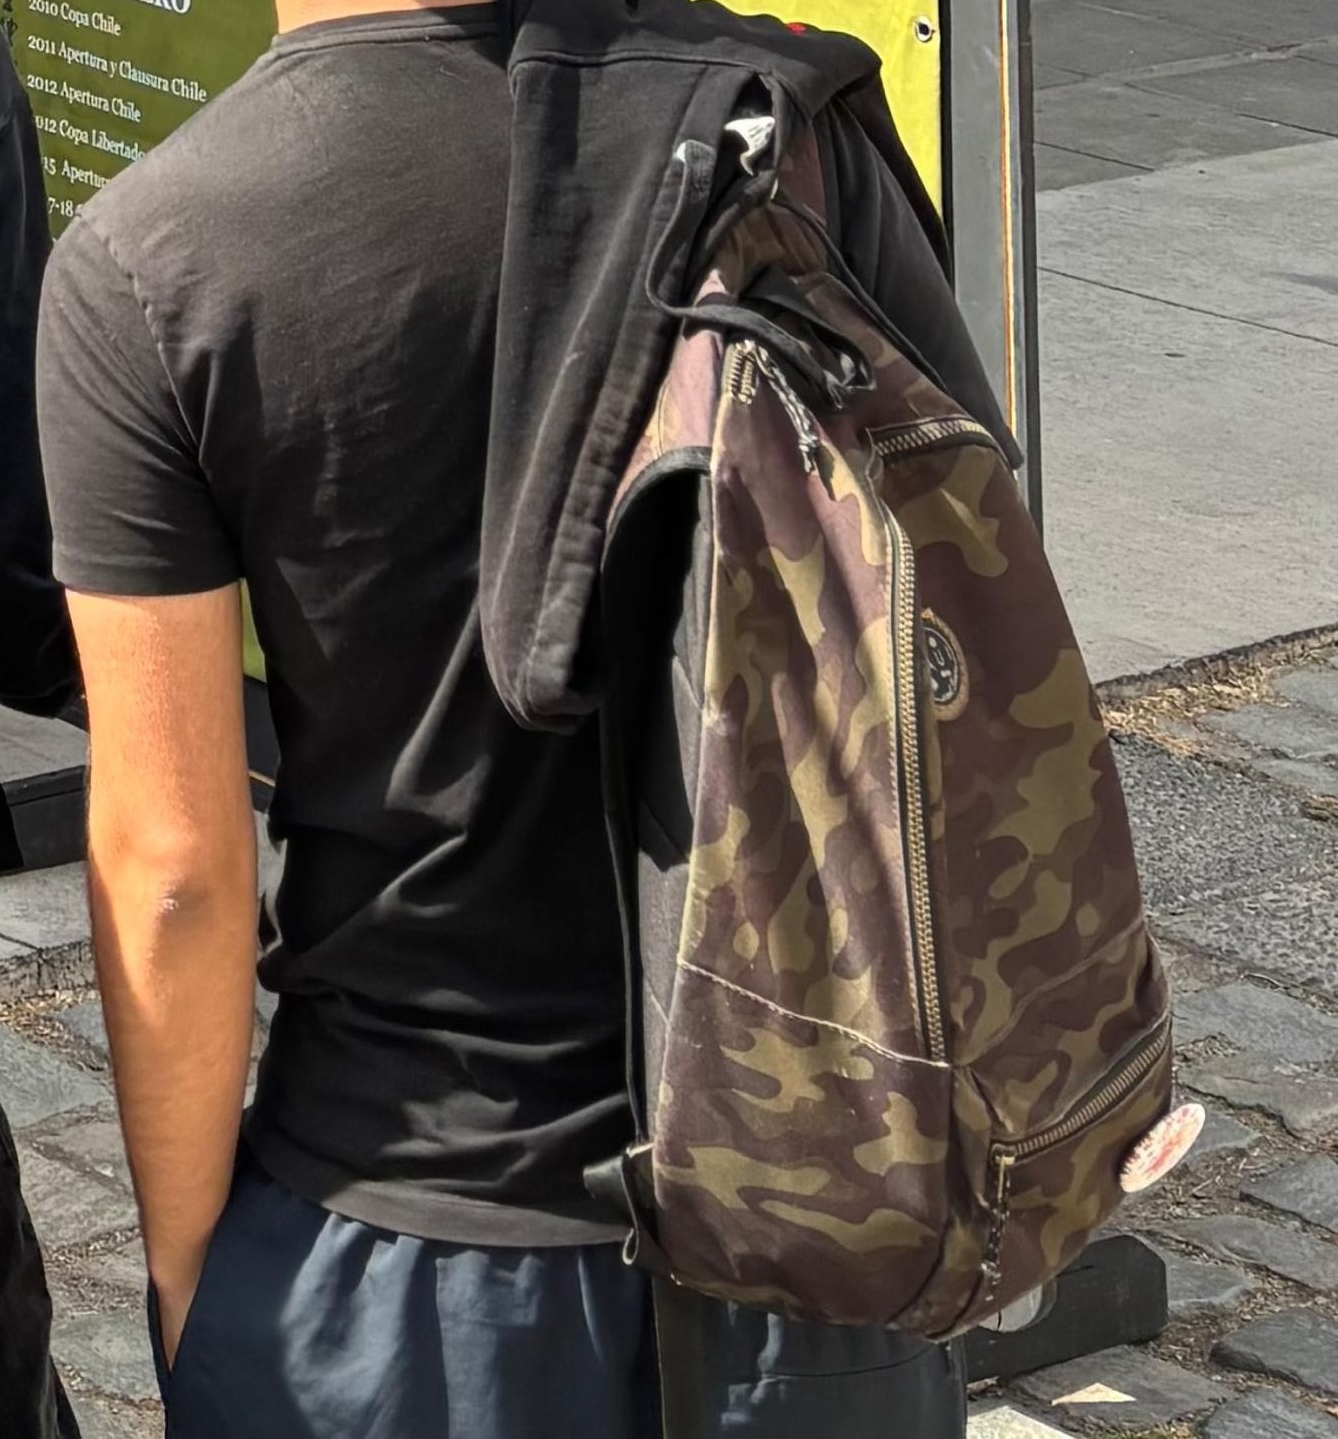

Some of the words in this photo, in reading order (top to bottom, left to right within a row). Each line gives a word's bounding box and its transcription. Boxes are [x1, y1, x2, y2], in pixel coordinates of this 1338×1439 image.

[60, 2, 90, 28] Copa
[91, 11, 122, 38] Chile
[27, 35, 57, 56] 2011
[59, 40, 108, 73] Apertura
[109, 60, 118, 78] y
[119, 60, 170, 92] Clausura
[171, 78, 207, 103] Chile
[27, 74, 58, 95] 2012
[61, 80, 109, 112] Apertura
[111, 97, 142, 123] Chile
[59, 119, 90, 145] Copa
